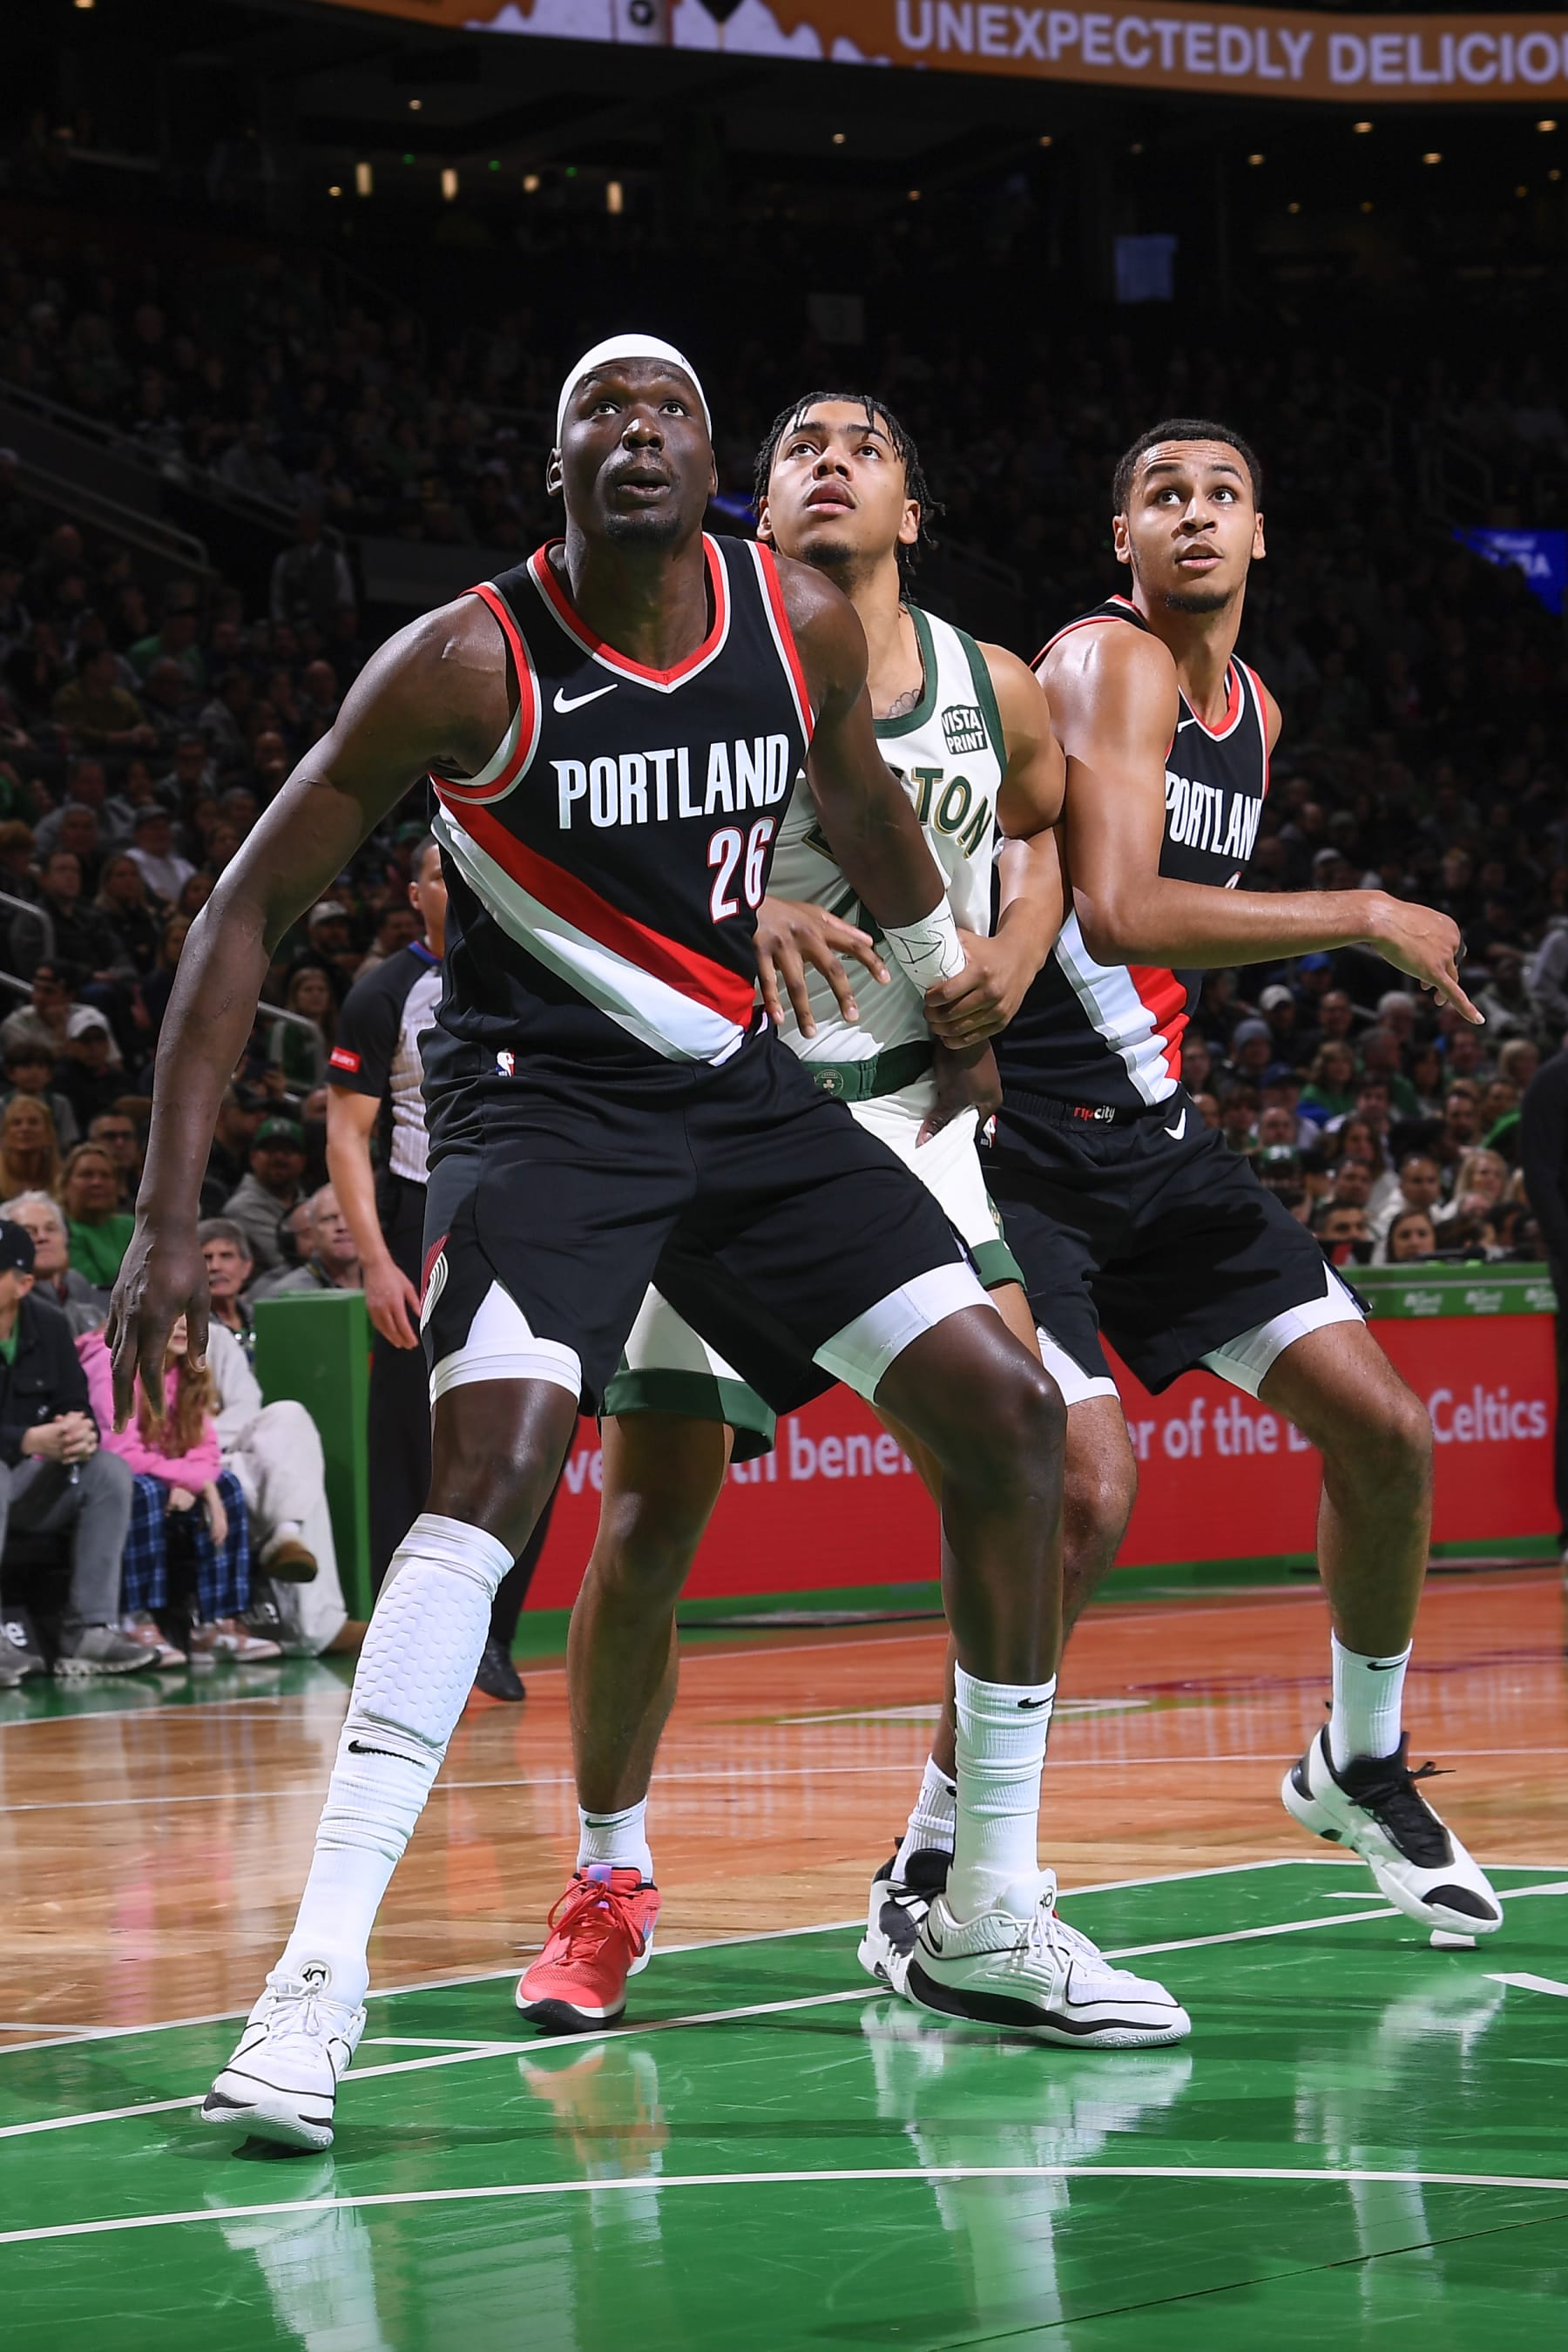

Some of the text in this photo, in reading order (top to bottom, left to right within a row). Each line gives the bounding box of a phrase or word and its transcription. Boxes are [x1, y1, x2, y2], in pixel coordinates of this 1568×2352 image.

[896, 0, 1314, 82] UNEXPECTEDLY
[941, 708, 983, 735] VISTA
[946, 730, 984, 754] PRINT
[549, 733, 789, 829] PORTLAND
[1165, 770, 1262, 861] PORTLAN
[707, 816, 777, 924] 26
[1163, 1397, 1206, 1459] of
[1213, 1396, 1278, 1456] the
[1428, 1385, 1548, 1443] Celtics
